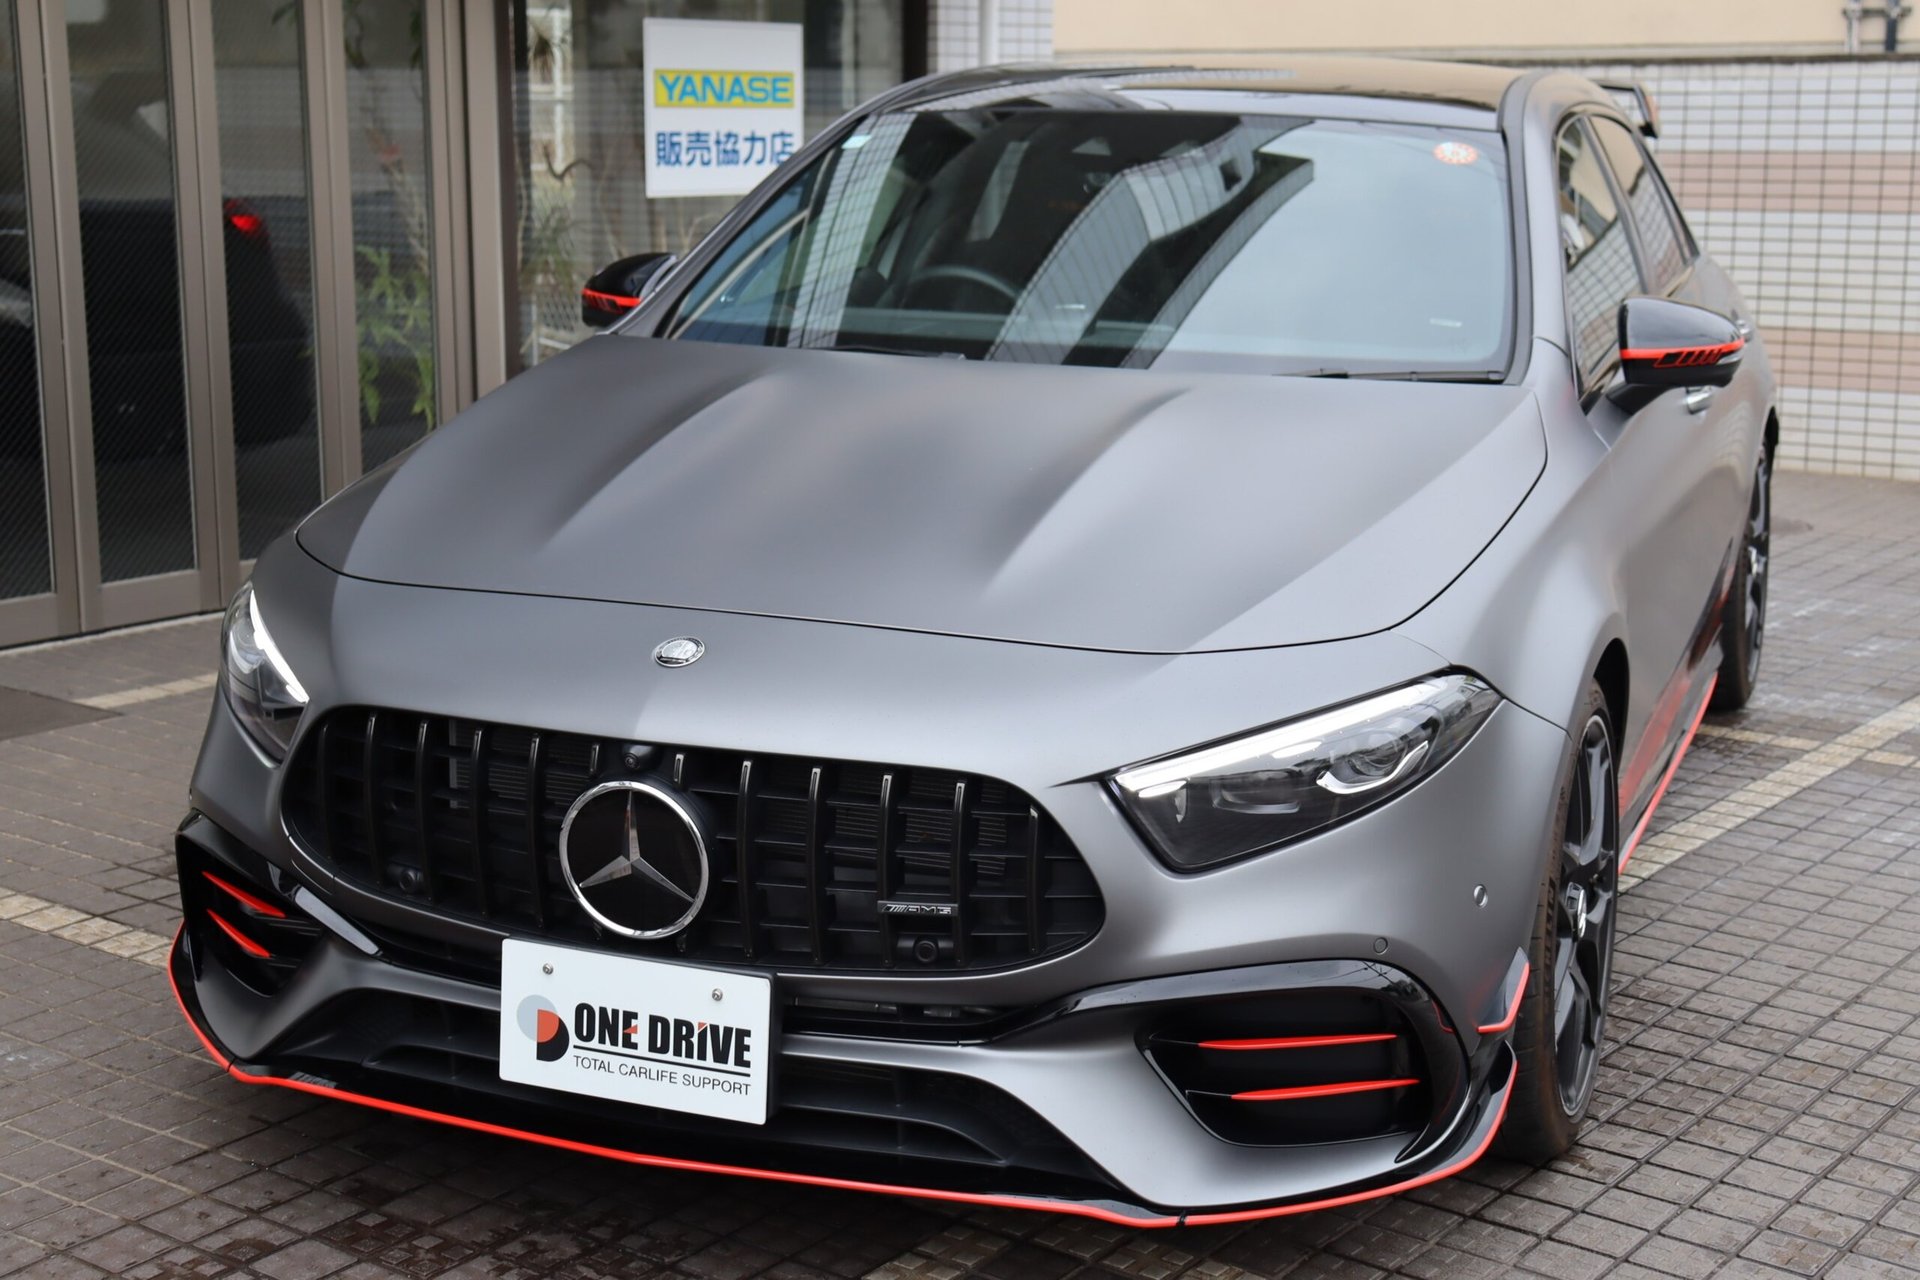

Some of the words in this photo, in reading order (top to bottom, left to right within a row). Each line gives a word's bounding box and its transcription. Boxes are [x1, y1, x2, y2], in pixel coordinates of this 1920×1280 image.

[659, 75, 793, 103] YANASE
[656, 131, 794, 167] 販売協力店
[903, 904, 952, 915] AMG
[574, 1002, 639, 1050] ONE
[573, 1055, 615, 1074] TOTAL
[619, 1063, 678, 1084] CARLIFE
[682, 1073, 751, 1096] SUPPORT
